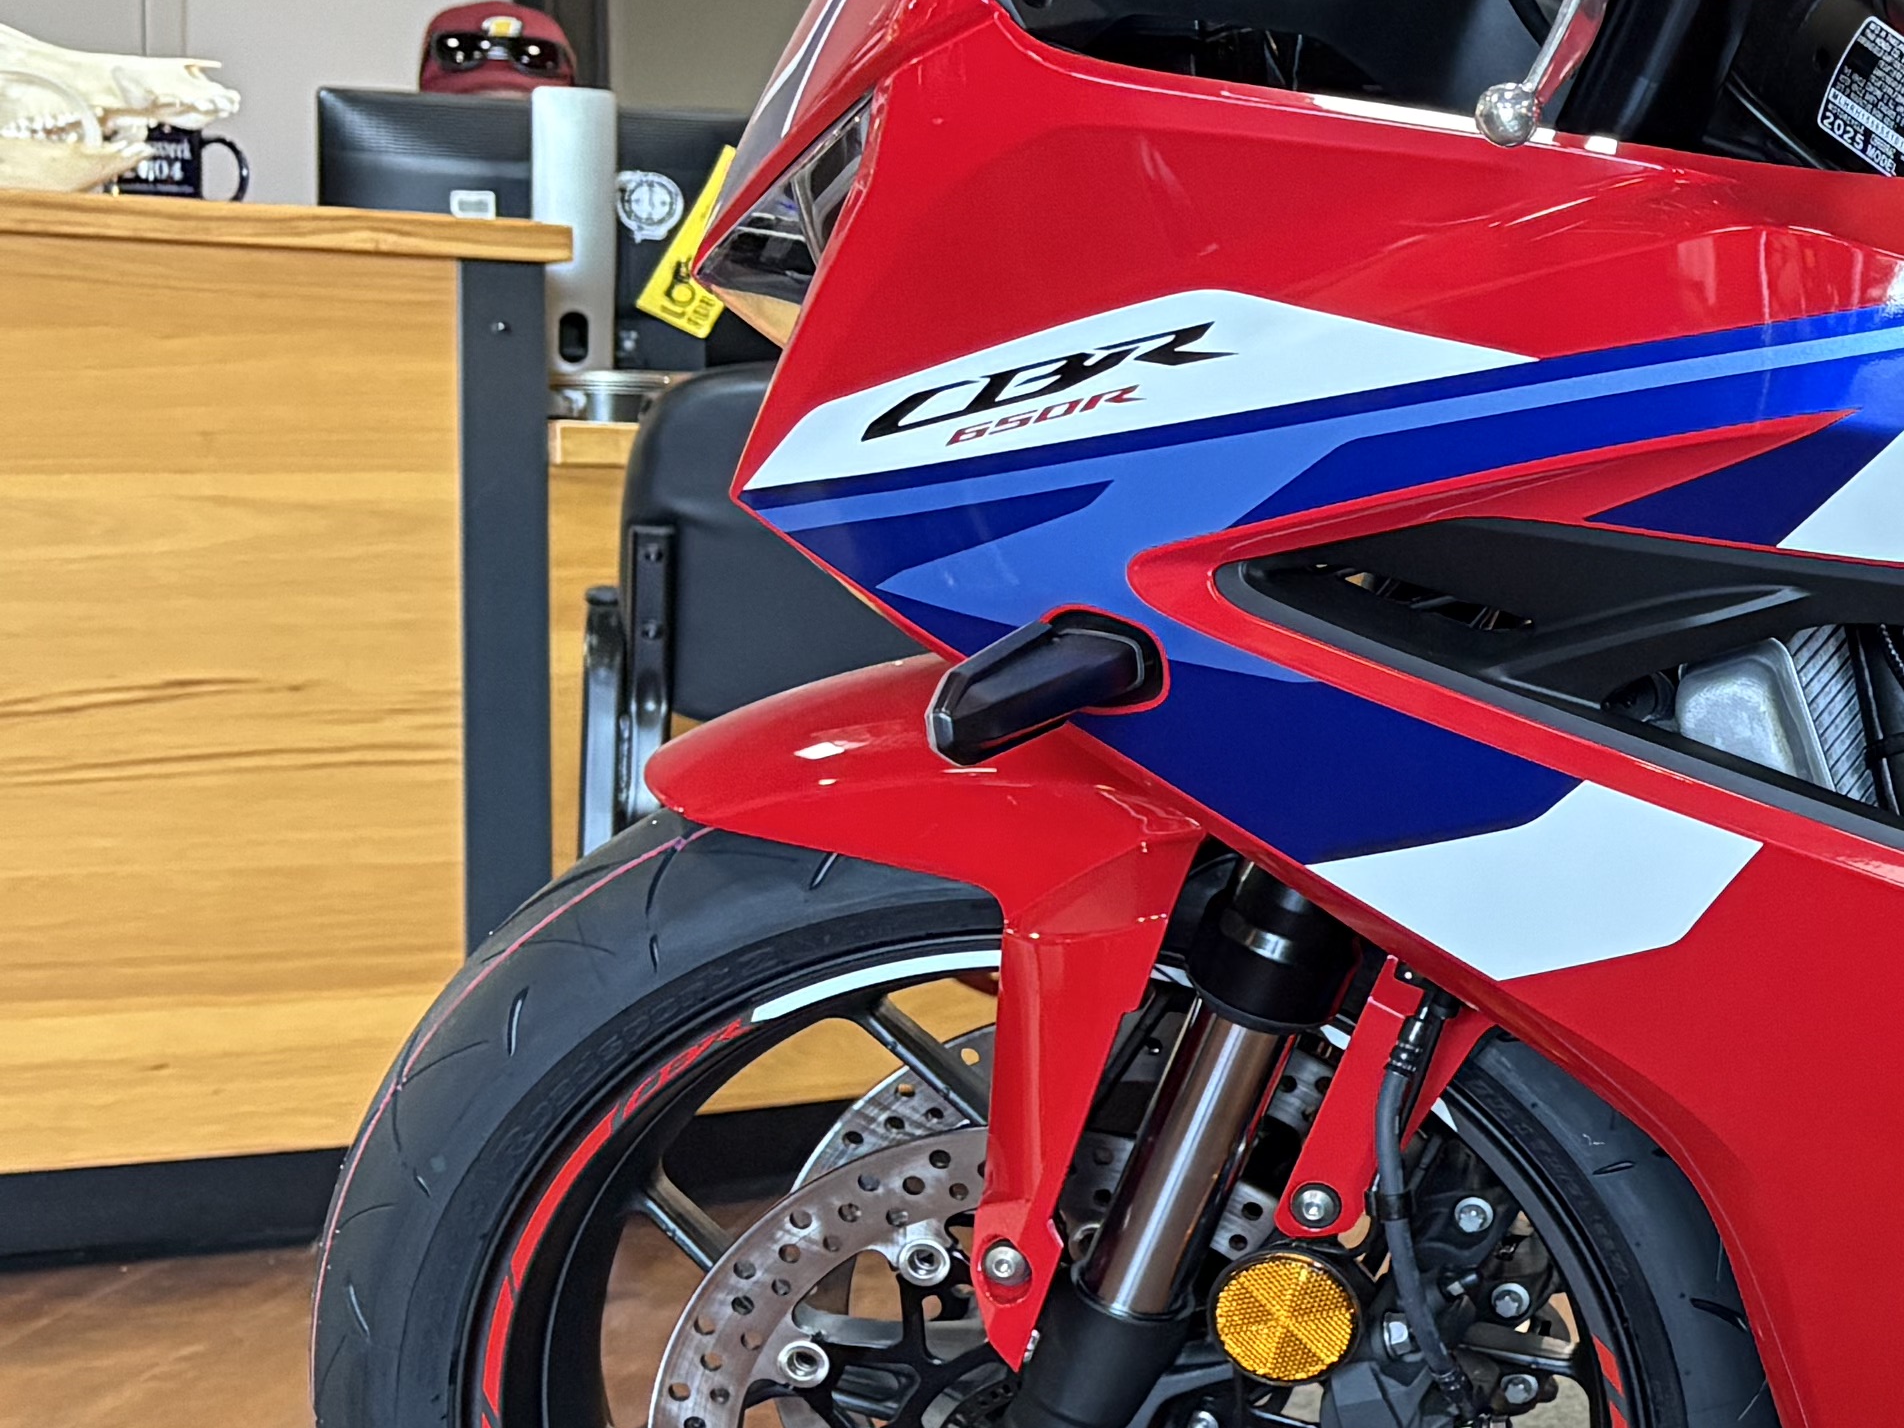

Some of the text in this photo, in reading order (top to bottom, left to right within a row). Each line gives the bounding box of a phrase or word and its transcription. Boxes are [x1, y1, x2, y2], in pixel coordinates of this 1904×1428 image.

[1823, 111, 1898, 177] 2025 MODEL
[860, 320, 1240, 443] CBR
[944, 384, 1148, 447] 650R
[622, 1016, 752, 1120] CBR
